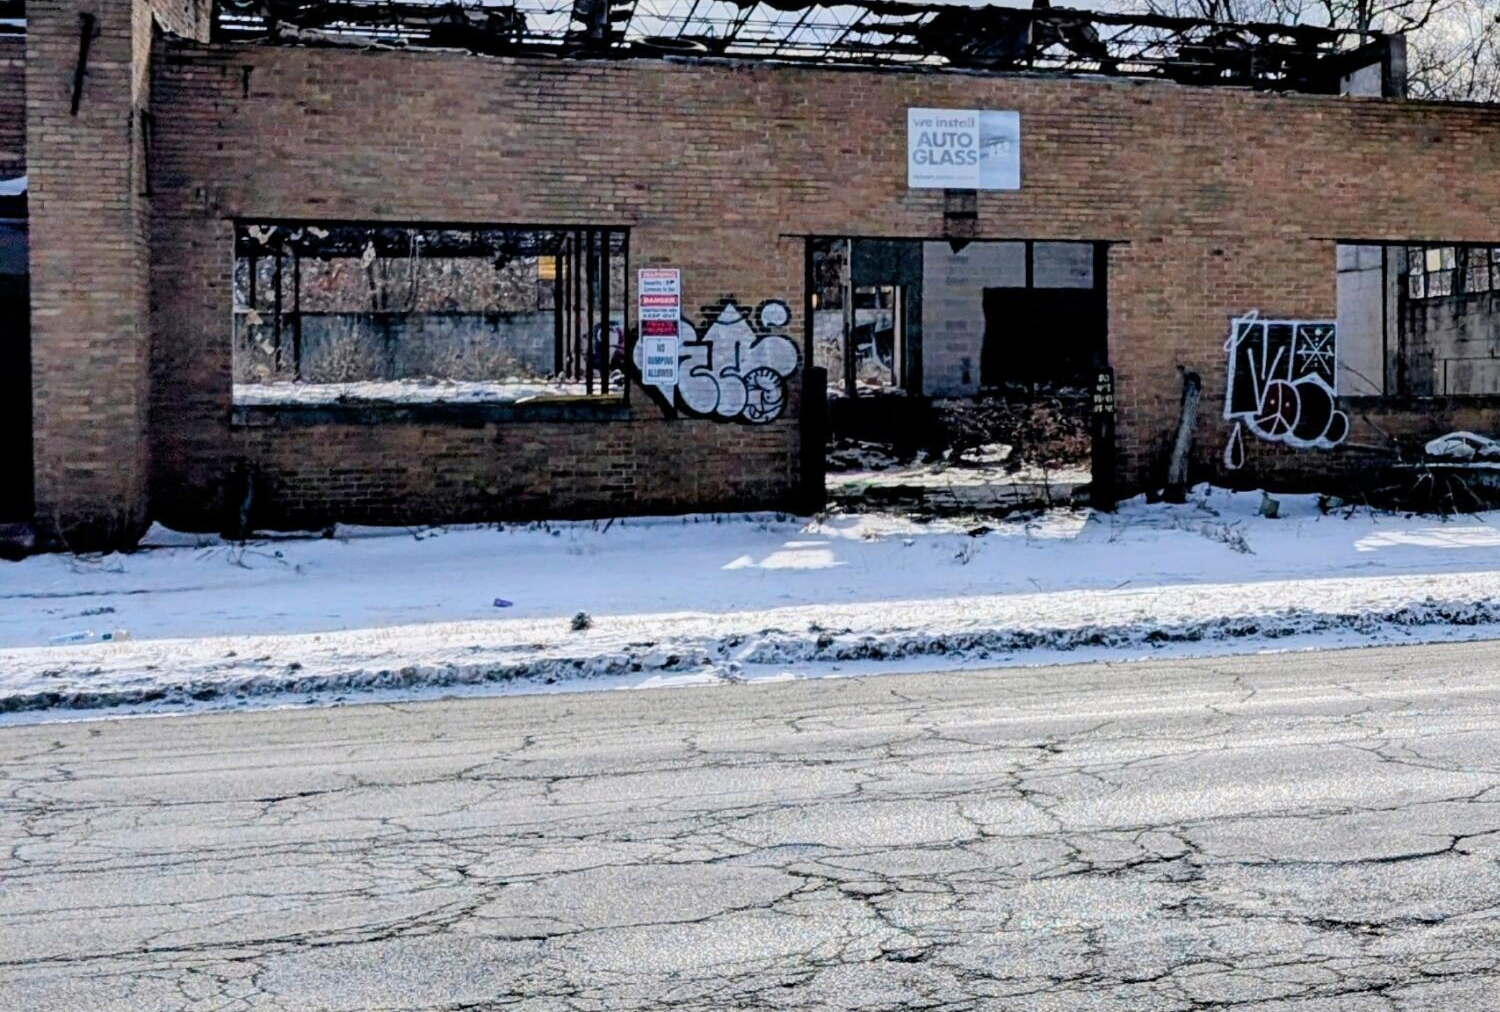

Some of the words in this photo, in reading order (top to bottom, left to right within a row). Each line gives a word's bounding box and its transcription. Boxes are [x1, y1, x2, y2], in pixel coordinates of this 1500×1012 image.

[913, 119, 933, 127] we
[936, 116, 976, 128] install
[917, 132, 973, 148] AUTO
[912, 148, 977, 165] GLASS
[657, 344, 665, 352] NO
[648, 356, 673, 365] DUMPING
[648, 369, 673, 377] ALLOWED
